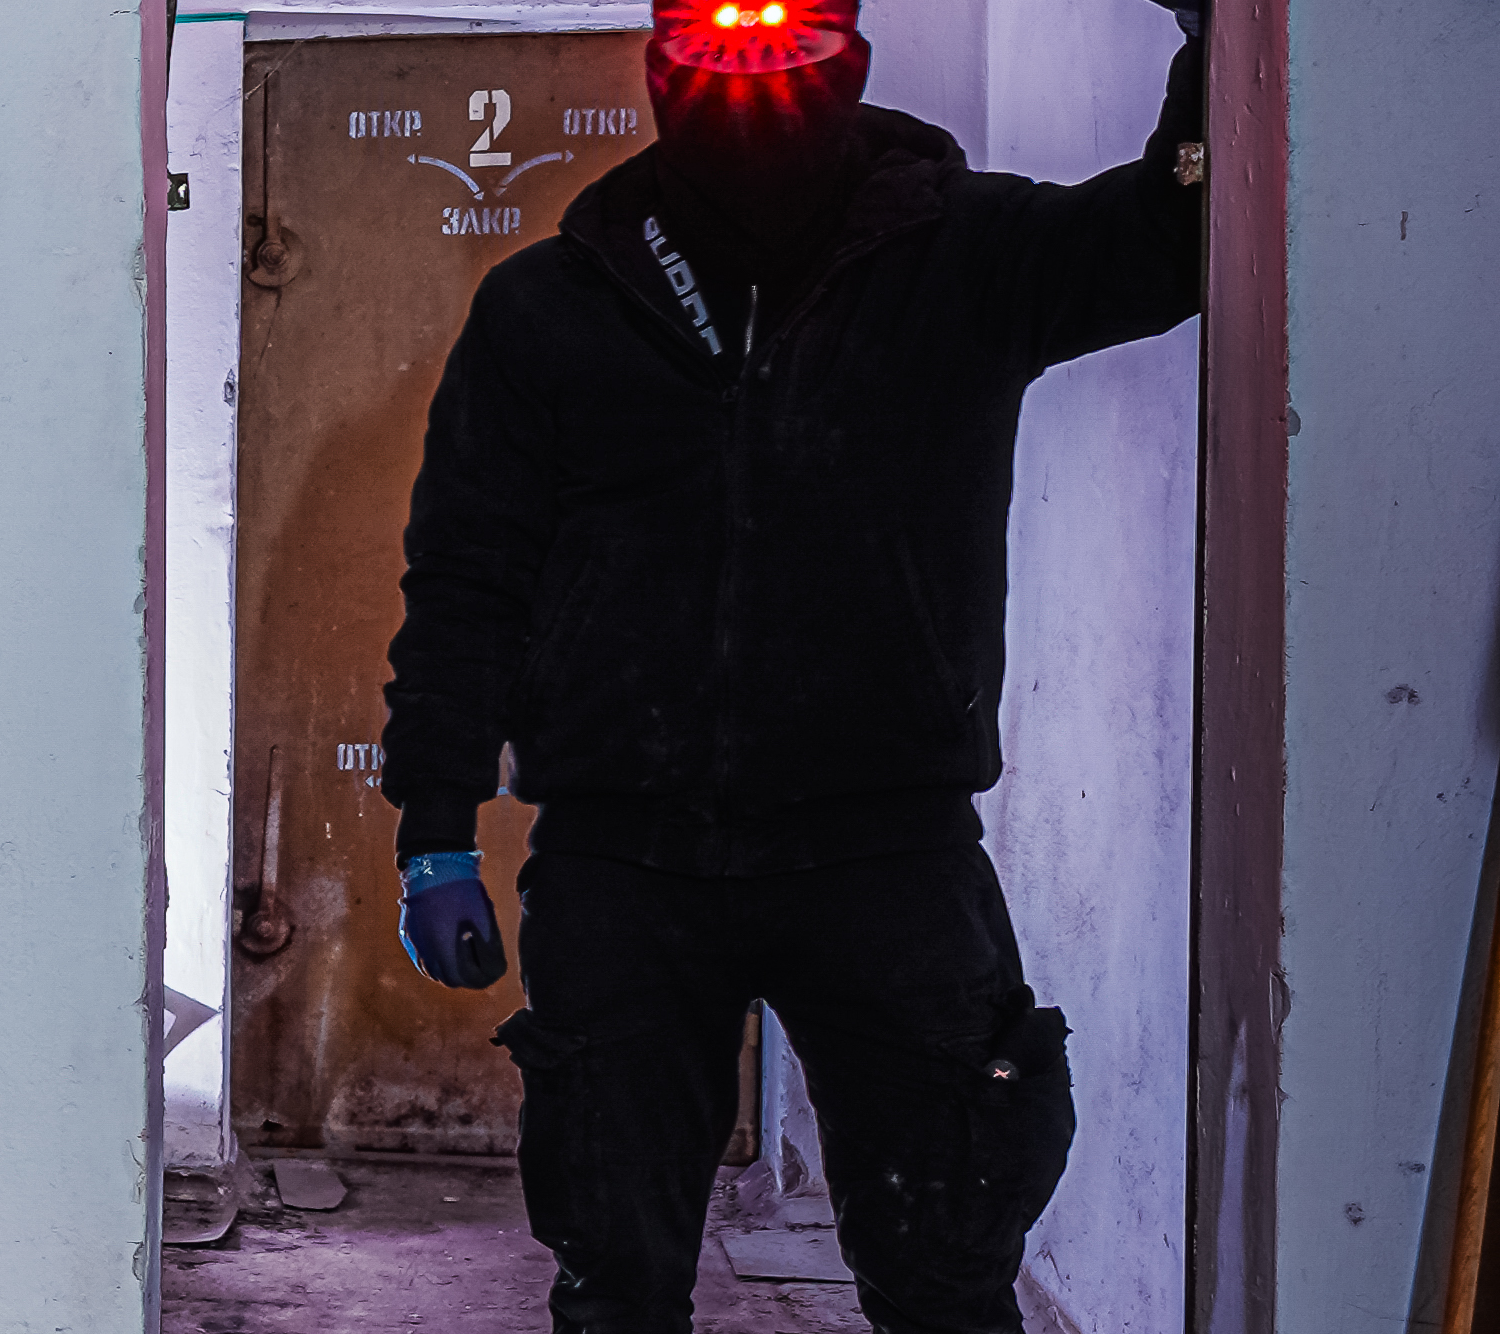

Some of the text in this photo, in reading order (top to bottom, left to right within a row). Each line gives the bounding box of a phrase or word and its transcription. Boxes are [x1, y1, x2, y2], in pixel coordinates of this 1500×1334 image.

[349, 110, 422, 139] ОТКР.
[469, 89, 511, 167] 2
[563, 108, 638, 135] ОТКР.
[442, 207, 520, 235] ЗАКР.
